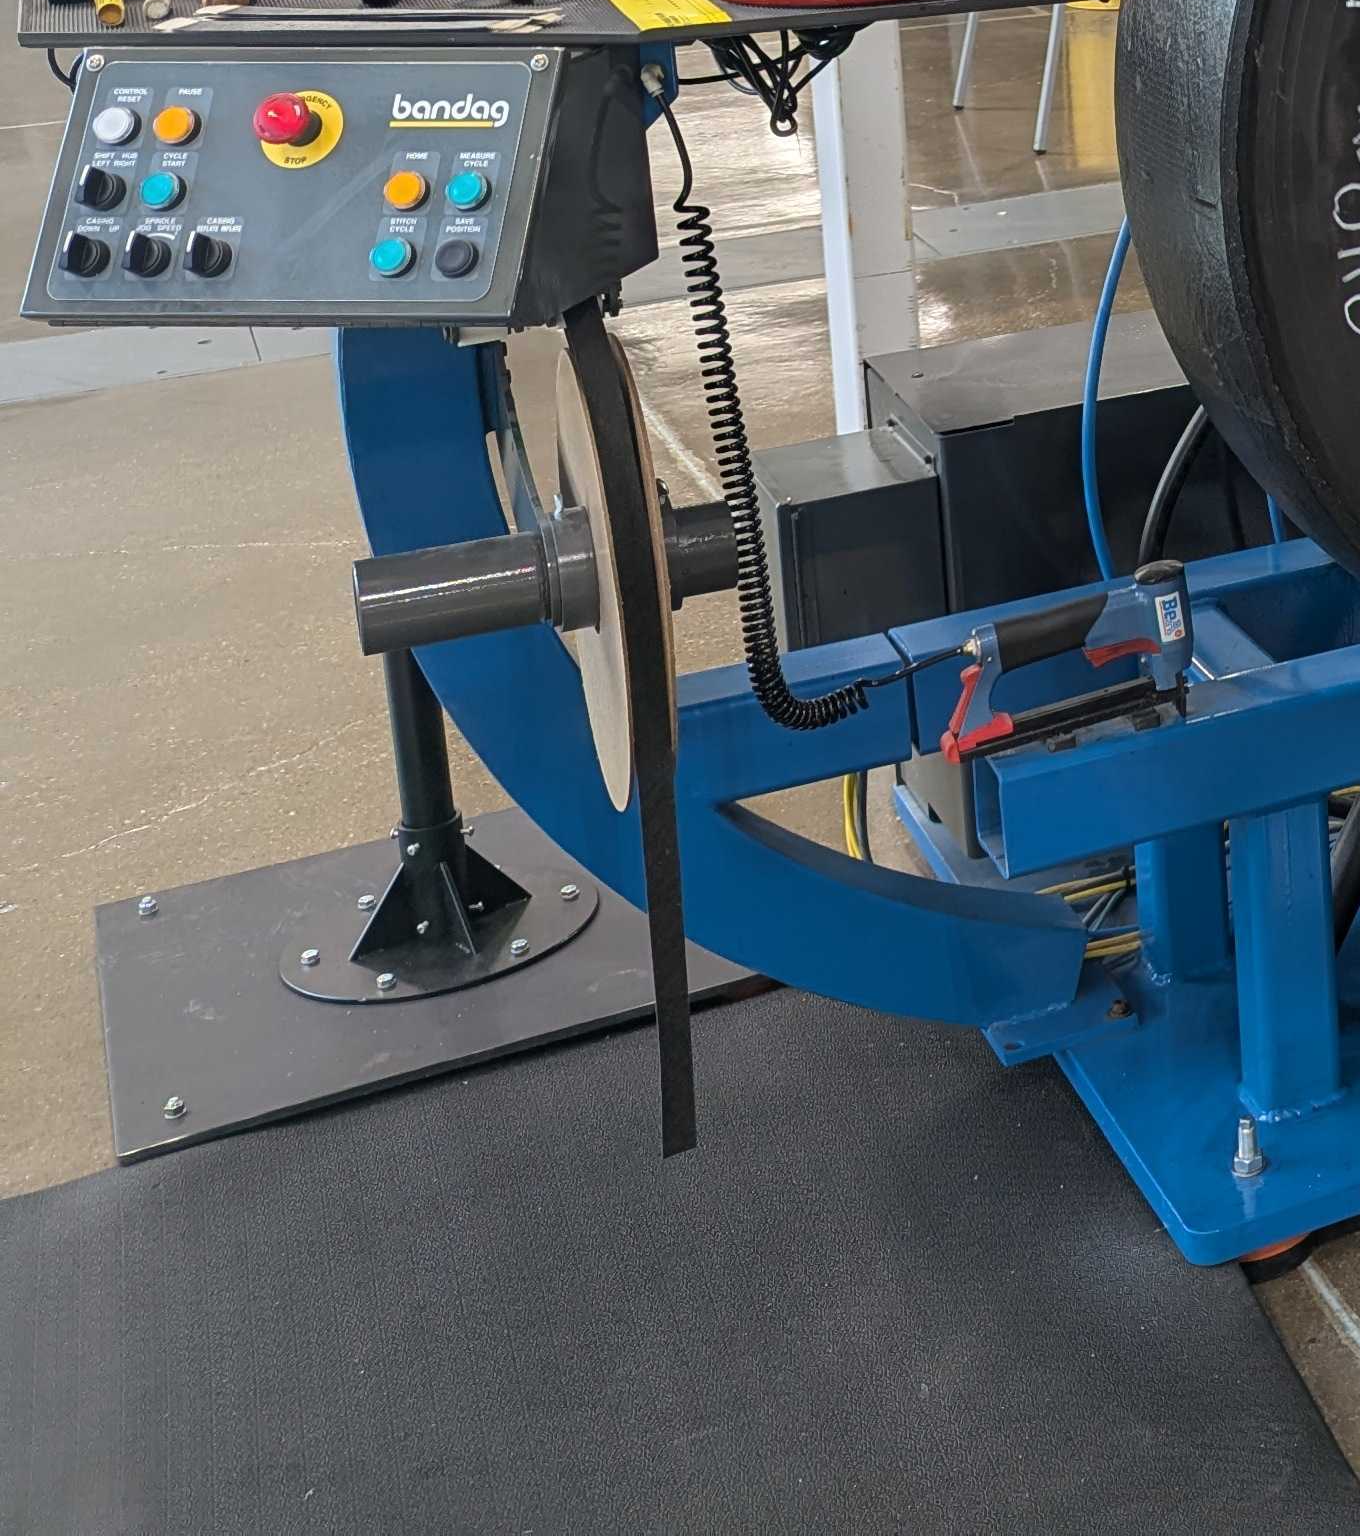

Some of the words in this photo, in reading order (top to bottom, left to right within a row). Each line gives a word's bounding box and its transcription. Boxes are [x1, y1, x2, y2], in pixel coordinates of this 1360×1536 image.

[113, 87, 148, 95] CONTROL
[116, 95, 142, 103] RESET
[391, 93, 510, 128] bandag
[405, 152, 429, 160] HOME
[459, 152, 496, 160] MEASURE
[161, 159, 187, 167] START
[283, 156, 308, 165] STOP
[144, 217, 177, 225] SPINDLE
[206, 217, 236, 225] CASING
[390, 217, 417, 225] STITCH
[455, 217, 474, 225] SAVE
[156, 224, 182, 232] SPEED
[389, 225, 415, 233] CYCLE
[445, 225, 481, 233] POSITION
